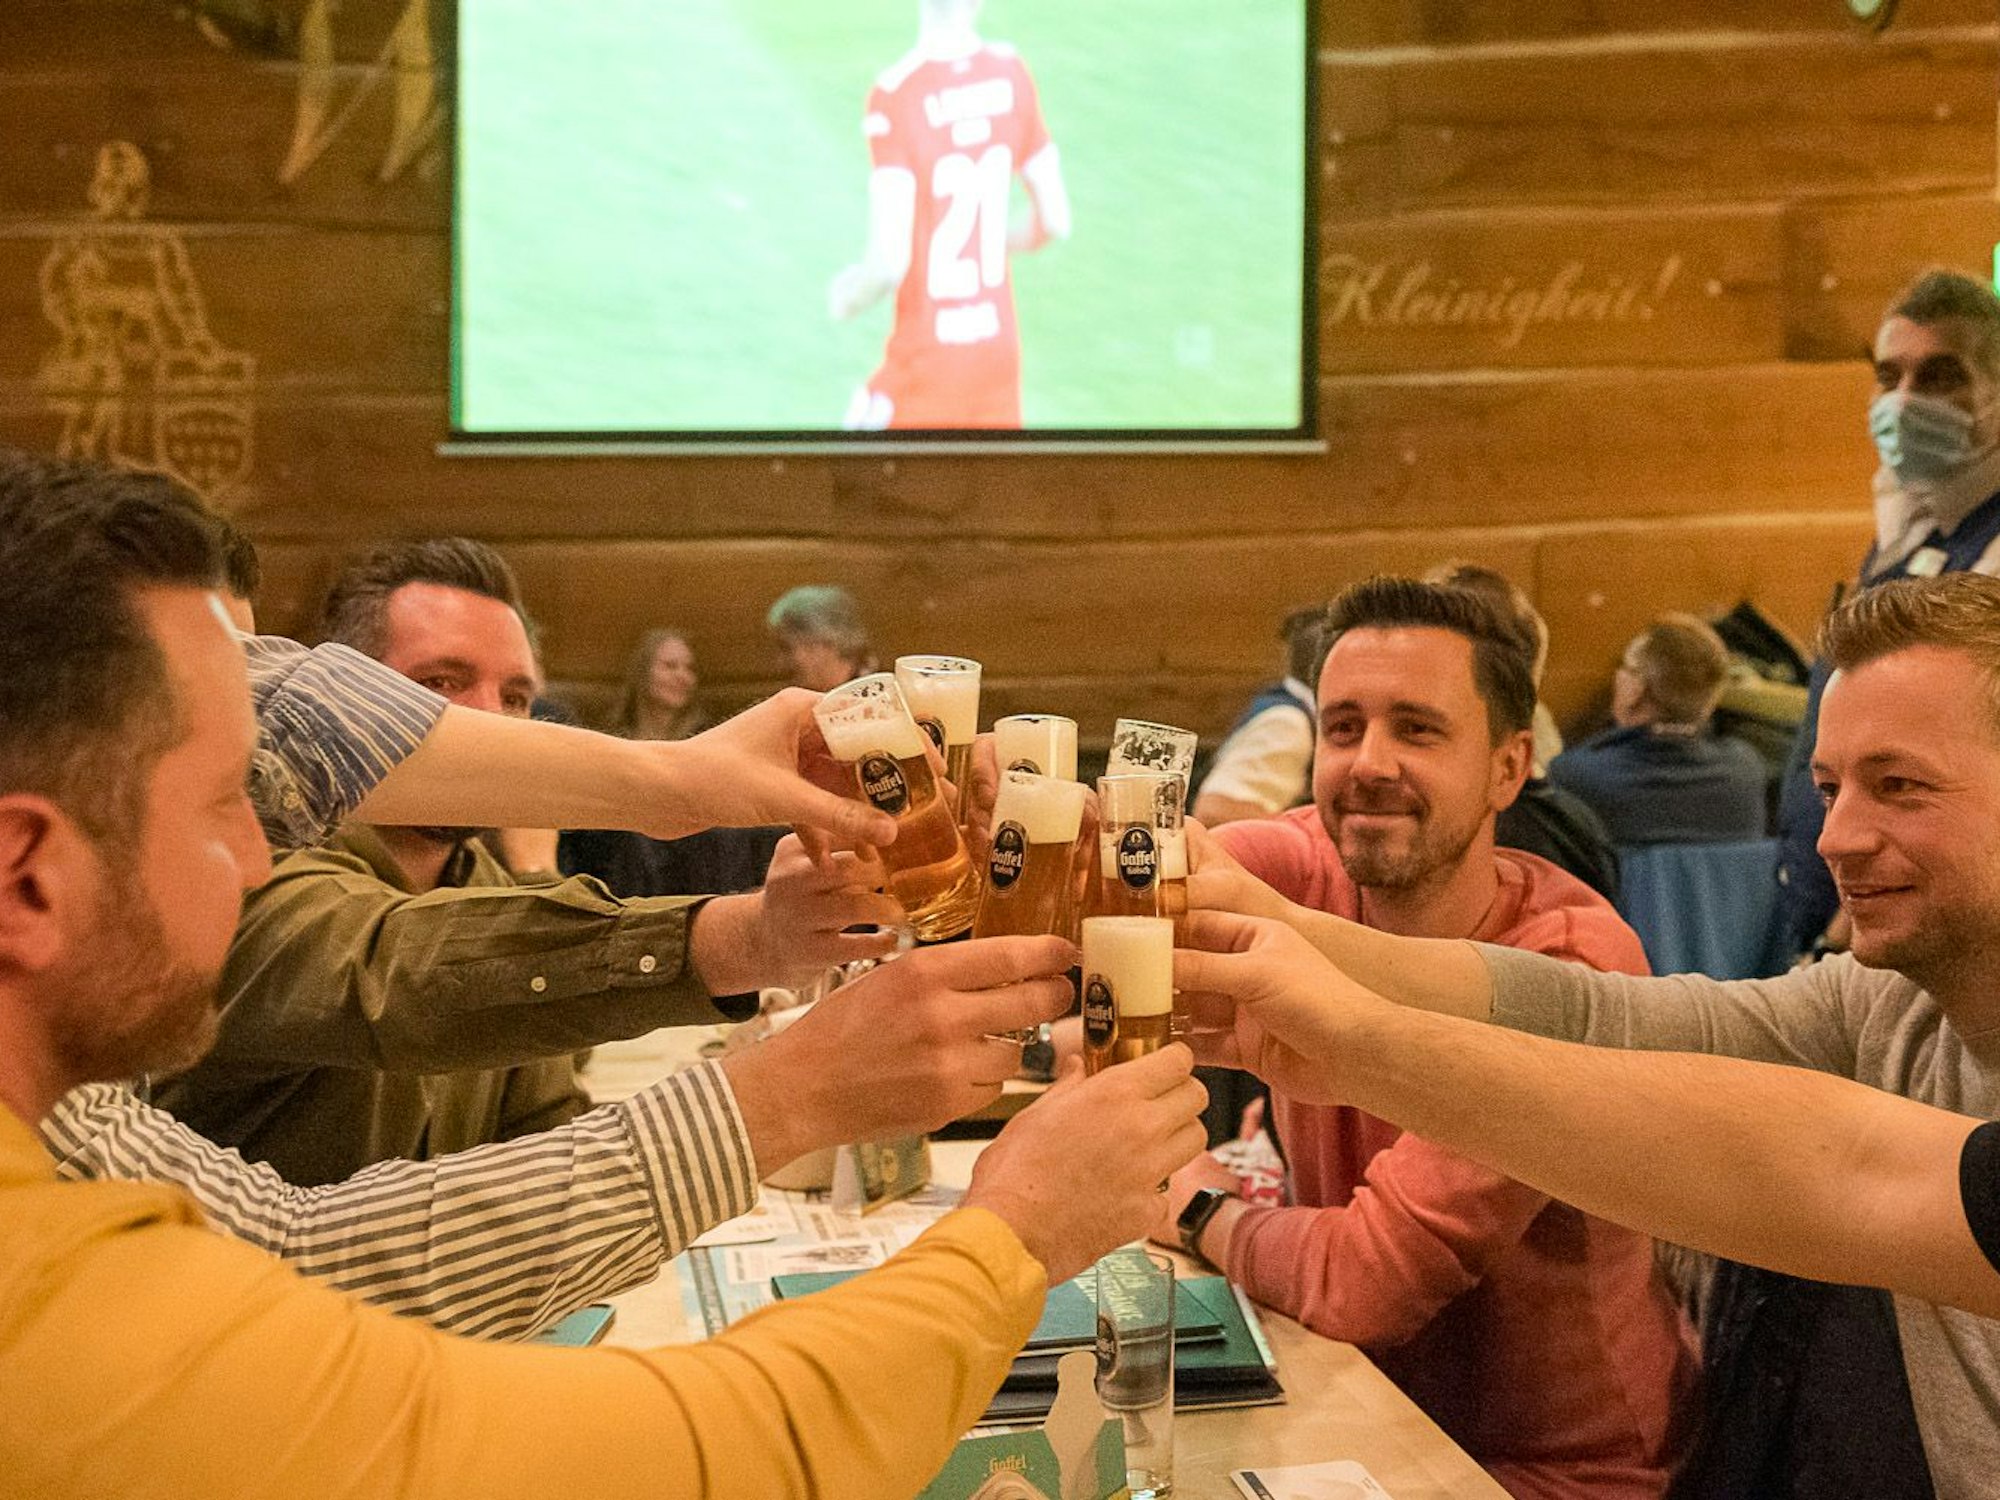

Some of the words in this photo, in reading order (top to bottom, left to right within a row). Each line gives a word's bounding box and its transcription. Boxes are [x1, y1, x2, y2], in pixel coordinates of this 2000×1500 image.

[928, 144, 1013, 300] 21
[1320, 253, 1682, 349] Kleinigkeit!
[865, 771, 903, 796] Gaffel
[991, 848, 1022, 868] Gaffel
[1120, 850, 1155, 867] Gaffel
[989, 1453, 1027, 1473] Gaffel
